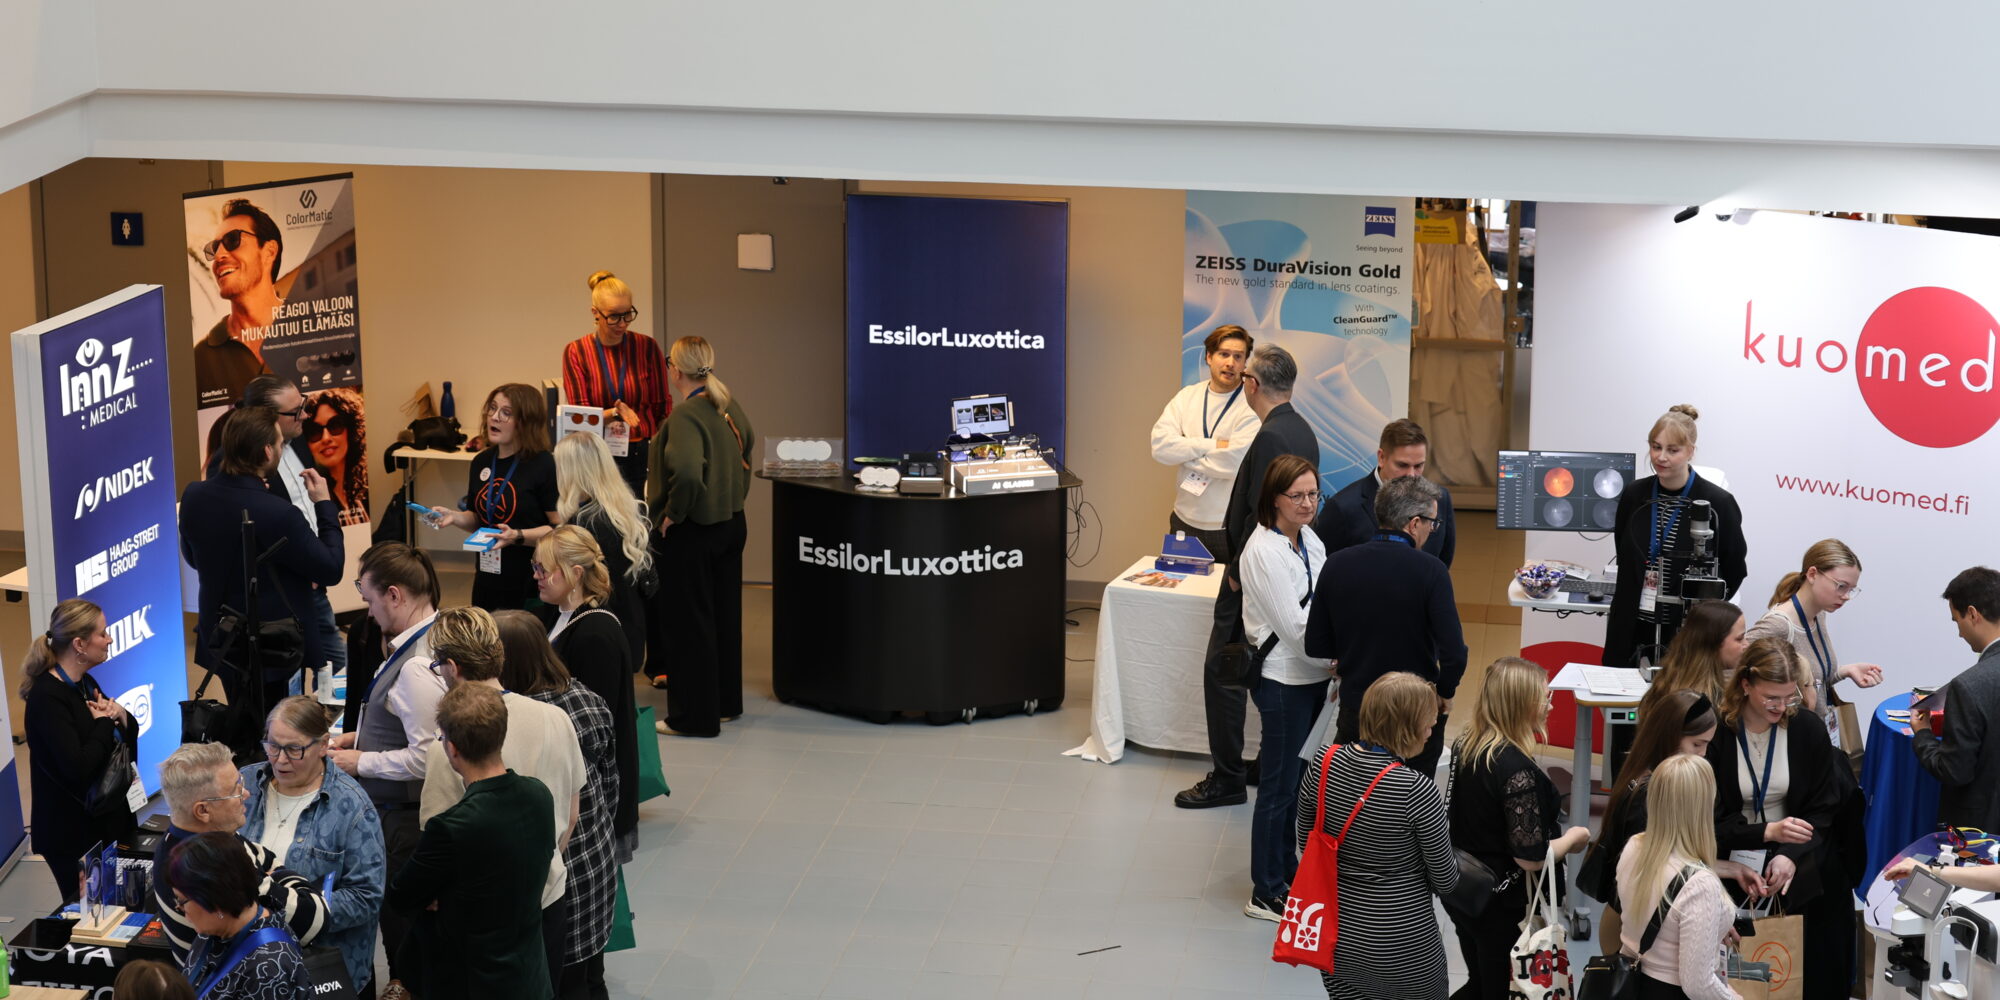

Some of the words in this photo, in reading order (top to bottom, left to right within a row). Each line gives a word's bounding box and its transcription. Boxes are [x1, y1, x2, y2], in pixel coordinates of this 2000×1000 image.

[286, 209, 333, 225] ColorMatic
[1366, 214, 1395, 224] ZEISS
[1356, 244, 1378, 253] Seeing
[1195, 255, 1246, 271] ZEISS
[1253, 258, 1352, 277] DuraVision
[1358, 264, 1401, 279] Gold
[1195, 273, 1214, 285] The
[1217, 277, 1240, 286] new
[1243, 277, 1266, 289] gold
[1269, 279, 1314, 290] standard
[1318, 281, 1327, 291] in
[1331, 281, 1351, 292] lens
[1354, 284, 1401, 296] coatings.
[271, 302, 310, 321] REAGOI
[312, 296, 354, 314] VALOON
[1354, 304, 1375, 313] With
[241, 320, 300, 342] MUKAUTUU
[302, 311, 355, 333] ELÄMÄÄSI
[868, 324, 1046, 350] EssilorLuxottica
[1344, 327, 1388, 336] technology
[1743, 299, 1996, 393] kuomed
[89, 392, 138, 428] MEDICAL
[105, 456, 154, 502] NIDEK
[1775, 474, 1970, 516] www.kuomed.fi
[109, 523, 160, 562] HAAG-STREIT
[798, 535, 1024, 576] EssilorLuxottica
[111, 551, 139, 578] GROUP
[103, 604, 155, 663] OLK
[314, 980, 343, 995] HOYA
